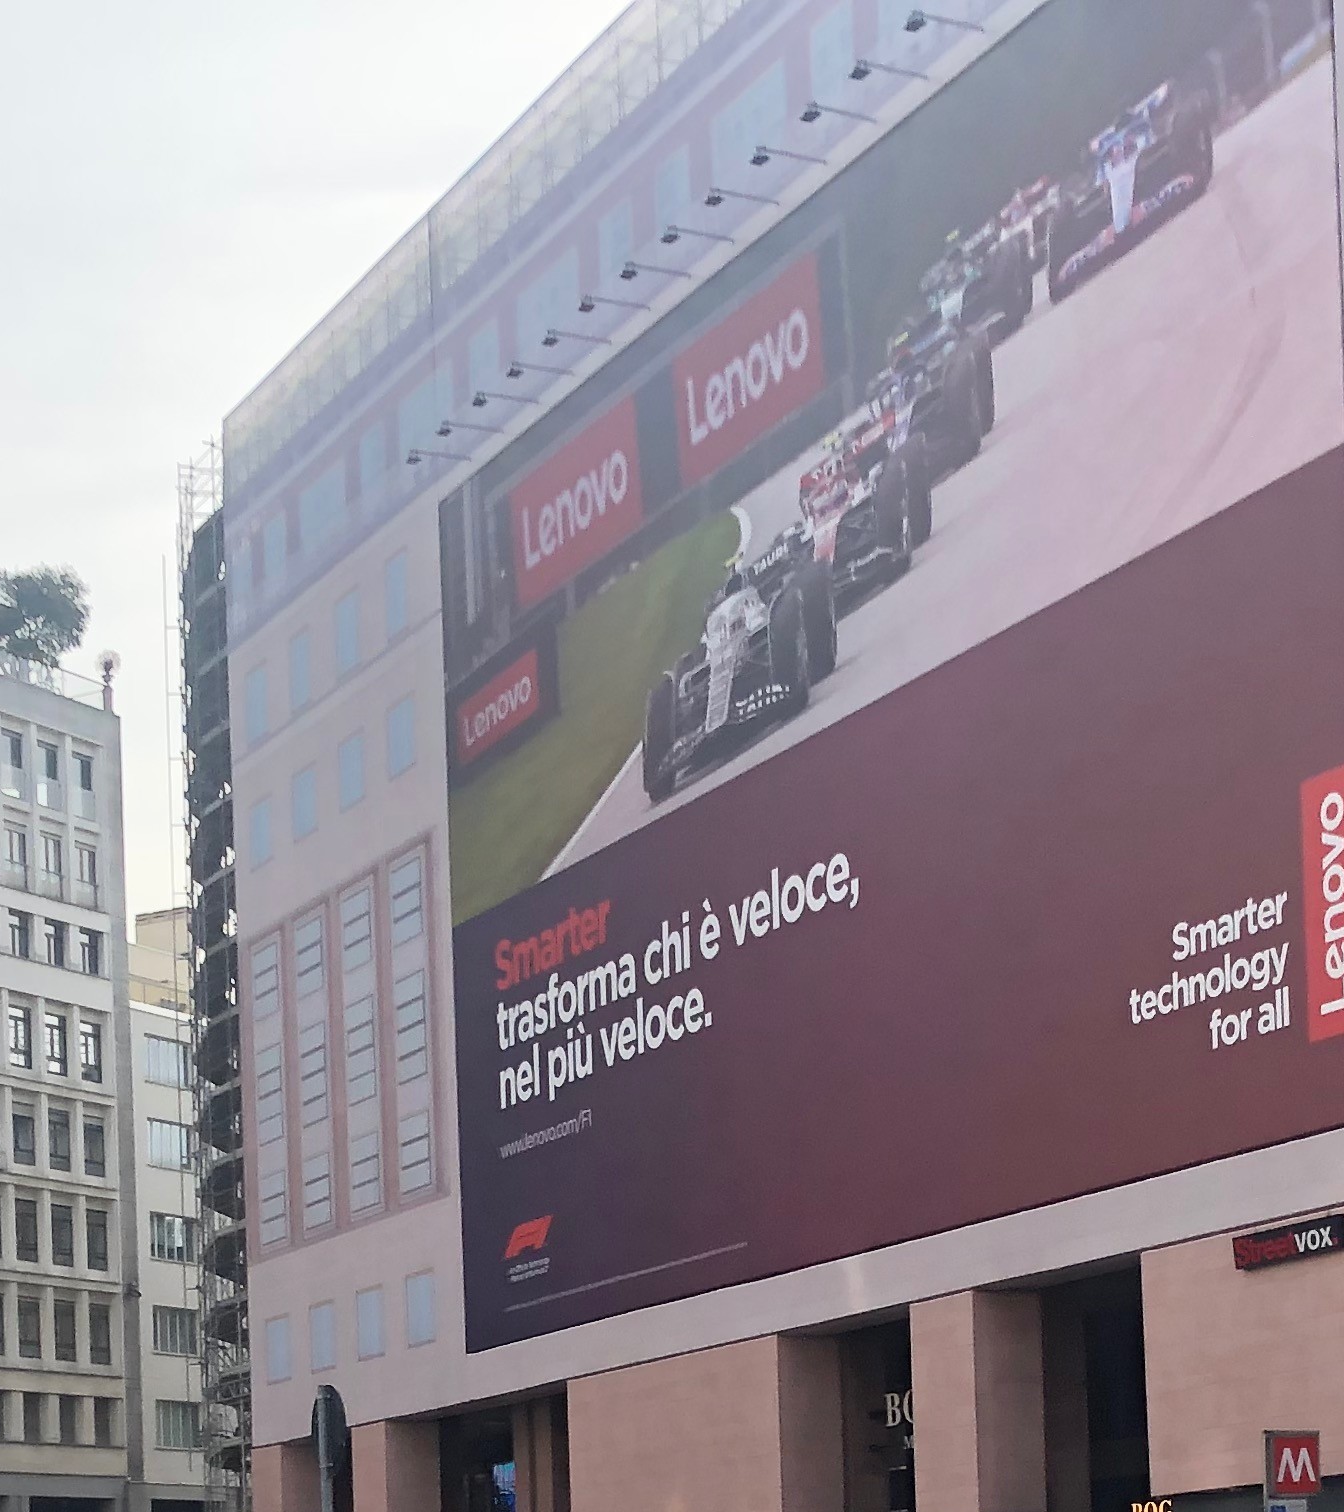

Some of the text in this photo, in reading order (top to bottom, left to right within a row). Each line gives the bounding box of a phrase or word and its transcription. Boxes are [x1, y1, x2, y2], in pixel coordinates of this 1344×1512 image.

[686, 308, 810, 446] Lenovo
[521, 449, 630, 570] Lenovo
[463, 674, 533, 747] Lenovo
[494, 900, 612, 991] Smarter
[496, 852, 862, 1051] trasforma chi è veloce,
[1172, 890, 1289, 962] Smarter
[1128, 942, 1291, 1025] technology
[1209, 986, 1291, 1050] for all
[499, 987, 714, 1110] nel più veloce.
[1276, 1447, 1317, 1483] M
